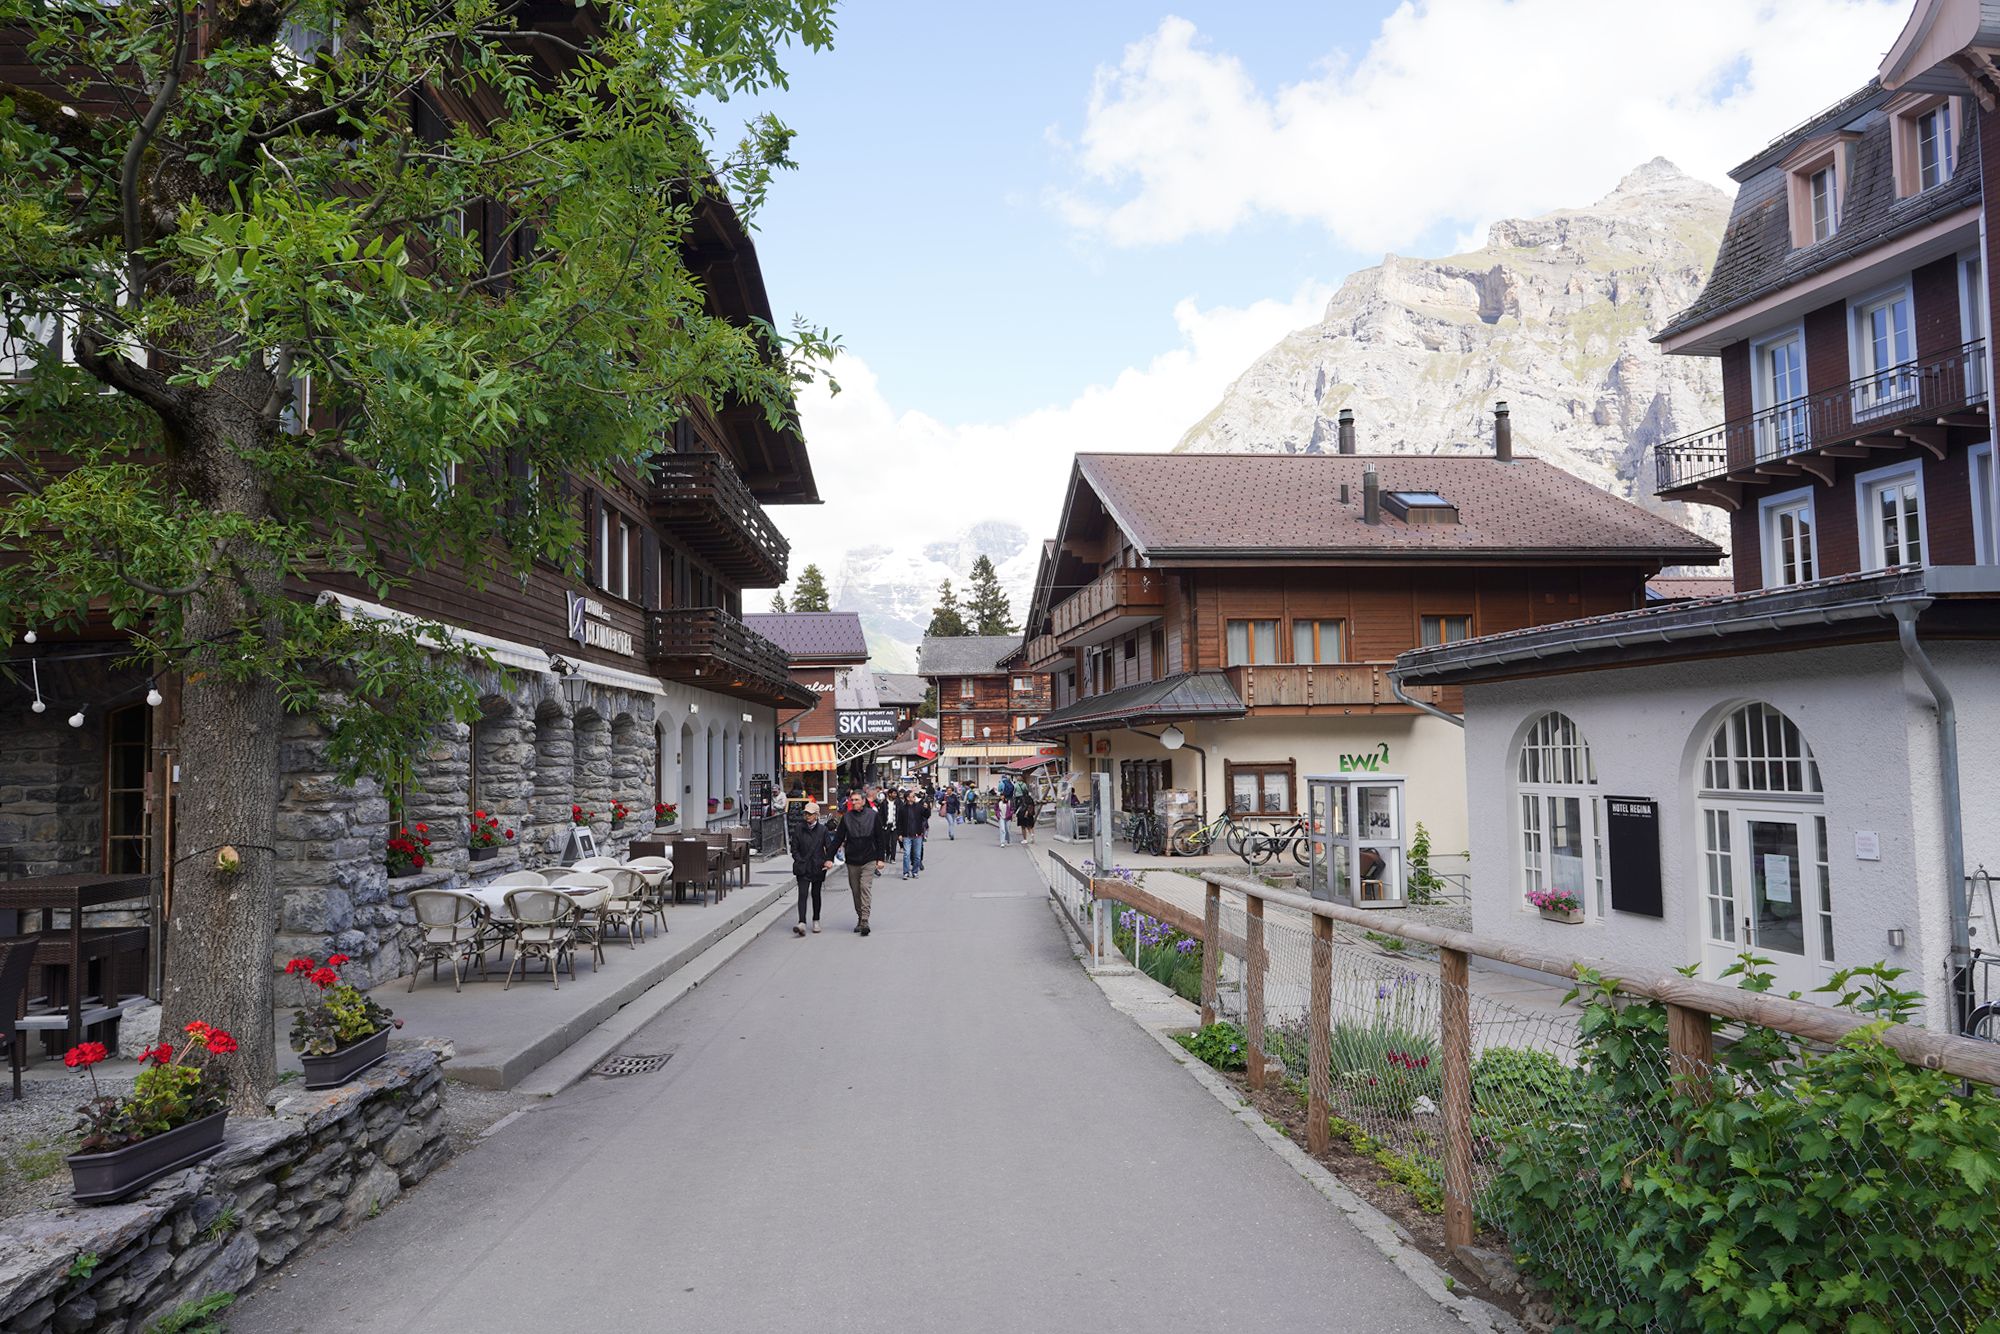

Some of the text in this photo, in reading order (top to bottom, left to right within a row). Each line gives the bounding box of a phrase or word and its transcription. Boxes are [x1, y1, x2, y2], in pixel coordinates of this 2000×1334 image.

[839, 715, 867, 734] SKI
[1339, 753, 1380, 772] EWL
[1612, 803, 1652, 814] HOTEL REGINA
